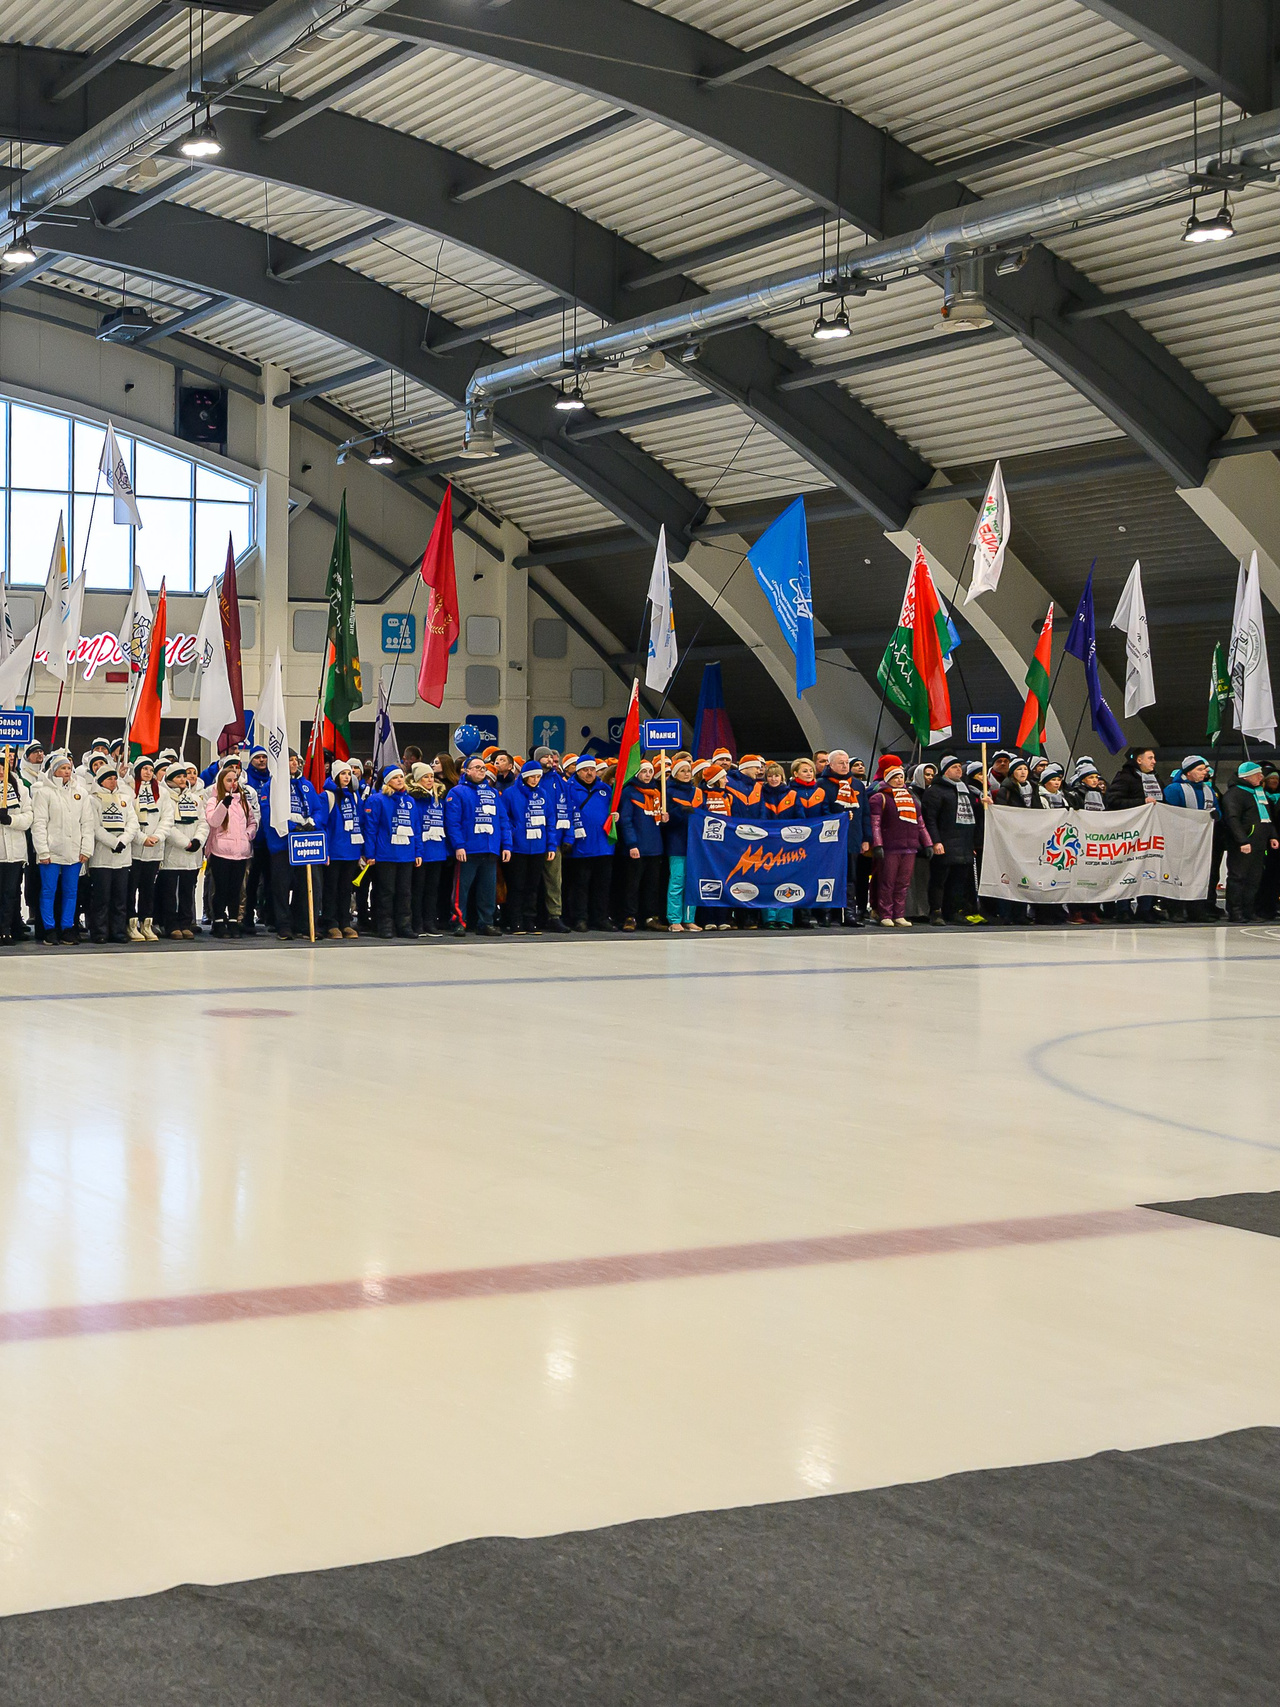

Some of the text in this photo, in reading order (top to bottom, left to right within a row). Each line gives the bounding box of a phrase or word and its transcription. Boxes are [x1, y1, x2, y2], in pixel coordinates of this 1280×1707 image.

[972, 723, 996, 734] Единые
[649, 730, 676, 739] Молния
[1084, 830, 1140, 841] КОМАНДА
[293, 838, 322, 848] Академия
[1085, 836, 1165, 860] ЕДИНЫЕ
[297, 848, 320, 857] сервиса
[724, 843, 808, 886] Молния
